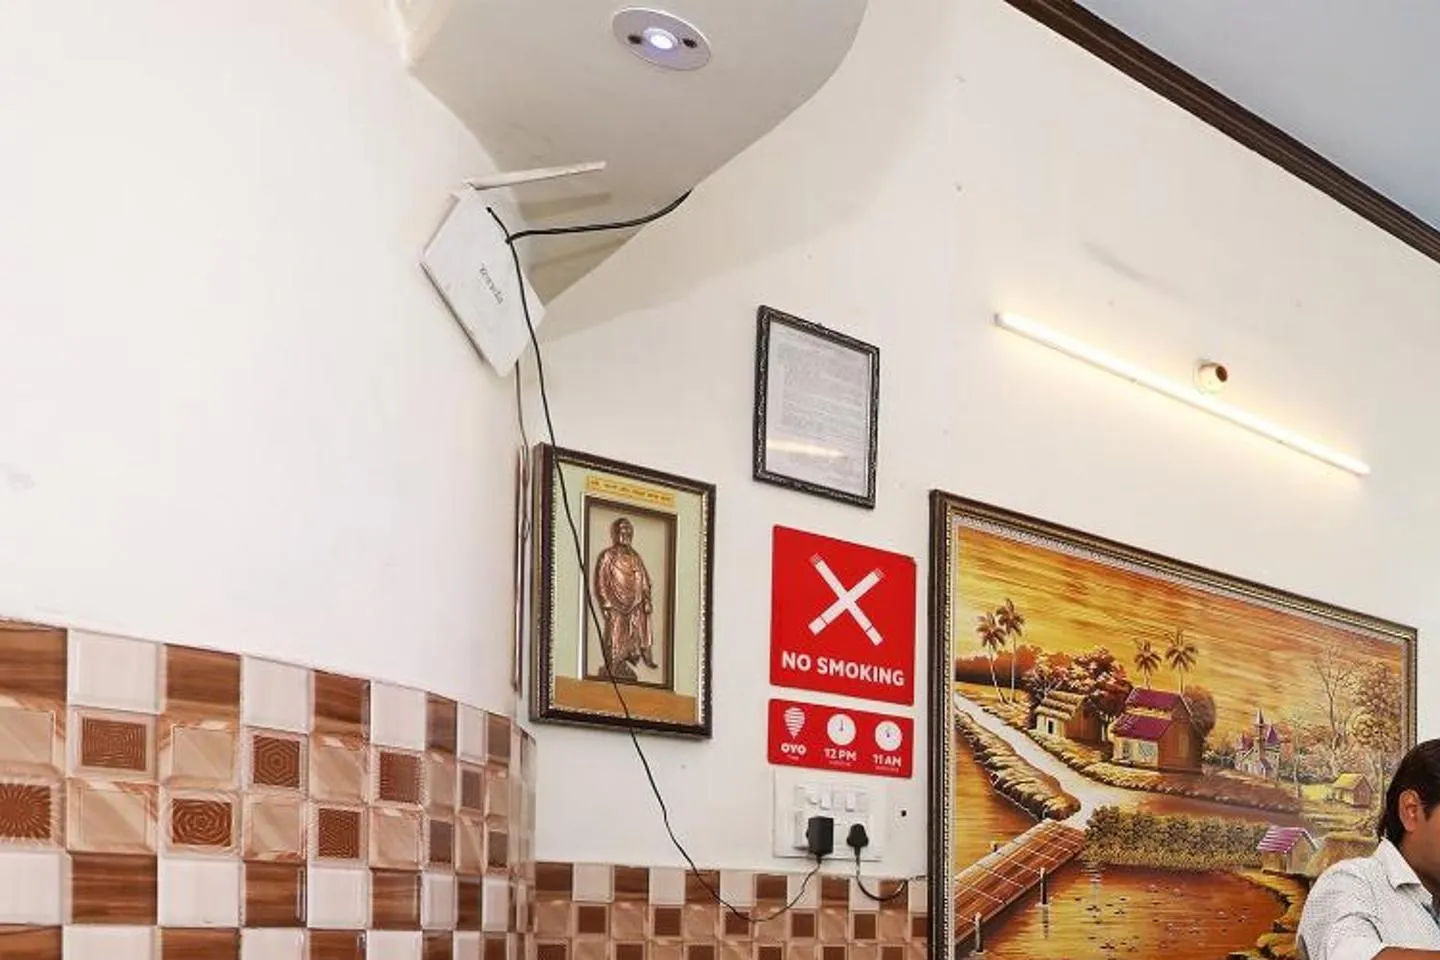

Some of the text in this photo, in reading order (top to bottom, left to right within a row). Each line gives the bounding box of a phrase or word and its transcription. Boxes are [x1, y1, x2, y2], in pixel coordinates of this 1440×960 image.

[782, 651, 904, 686] NO SMOKING
[780, 743, 807, 755] OYO
[824, 748, 857, 761] 12 PM
[872, 753, 902, 767] 11 AM
